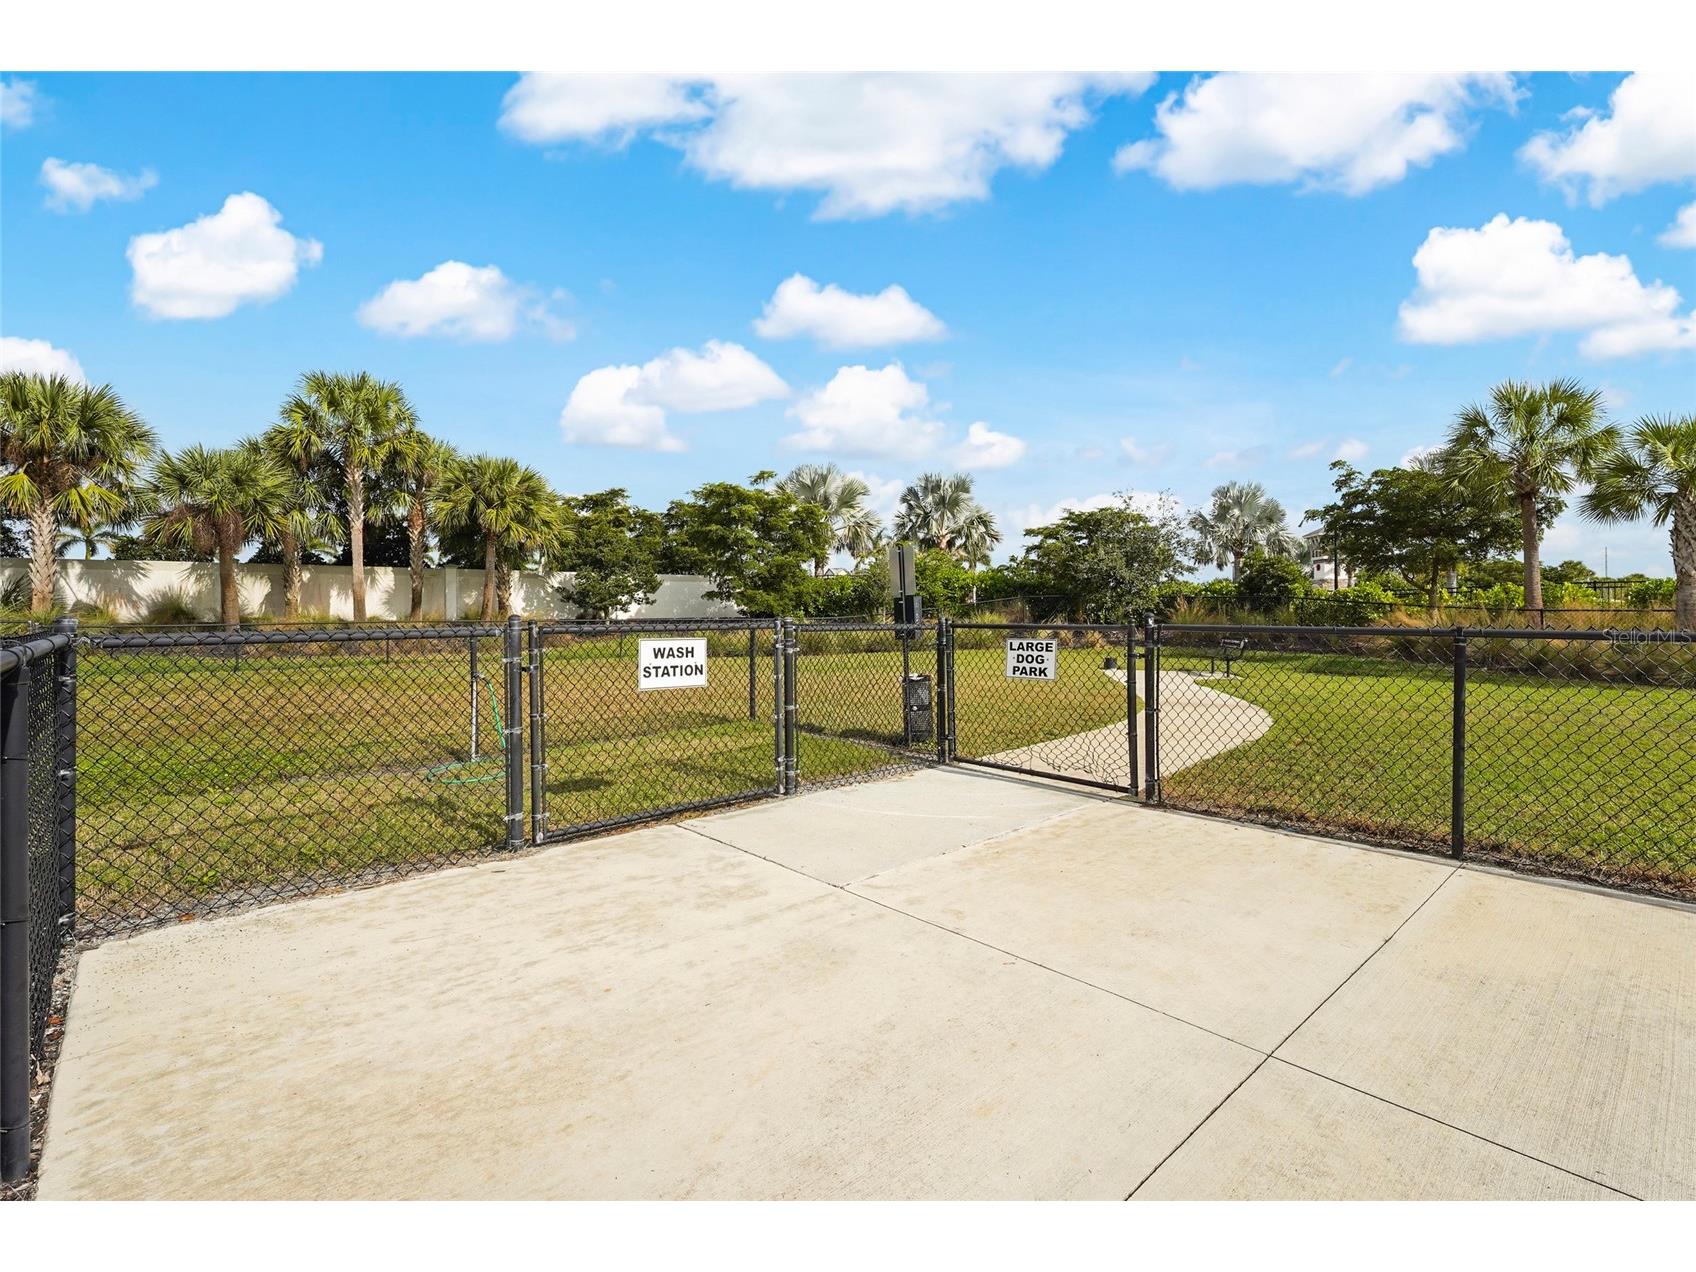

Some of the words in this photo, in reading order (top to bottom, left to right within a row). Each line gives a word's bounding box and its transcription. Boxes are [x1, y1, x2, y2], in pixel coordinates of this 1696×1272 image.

[653, 646, 694, 659] WASH
[1009, 641, 1053, 652] LARGE
[1016, 653, 1045, 664] DOG
[643, 664, 703, 678] STATION
[1012, 665, 1048, 677] PARK
